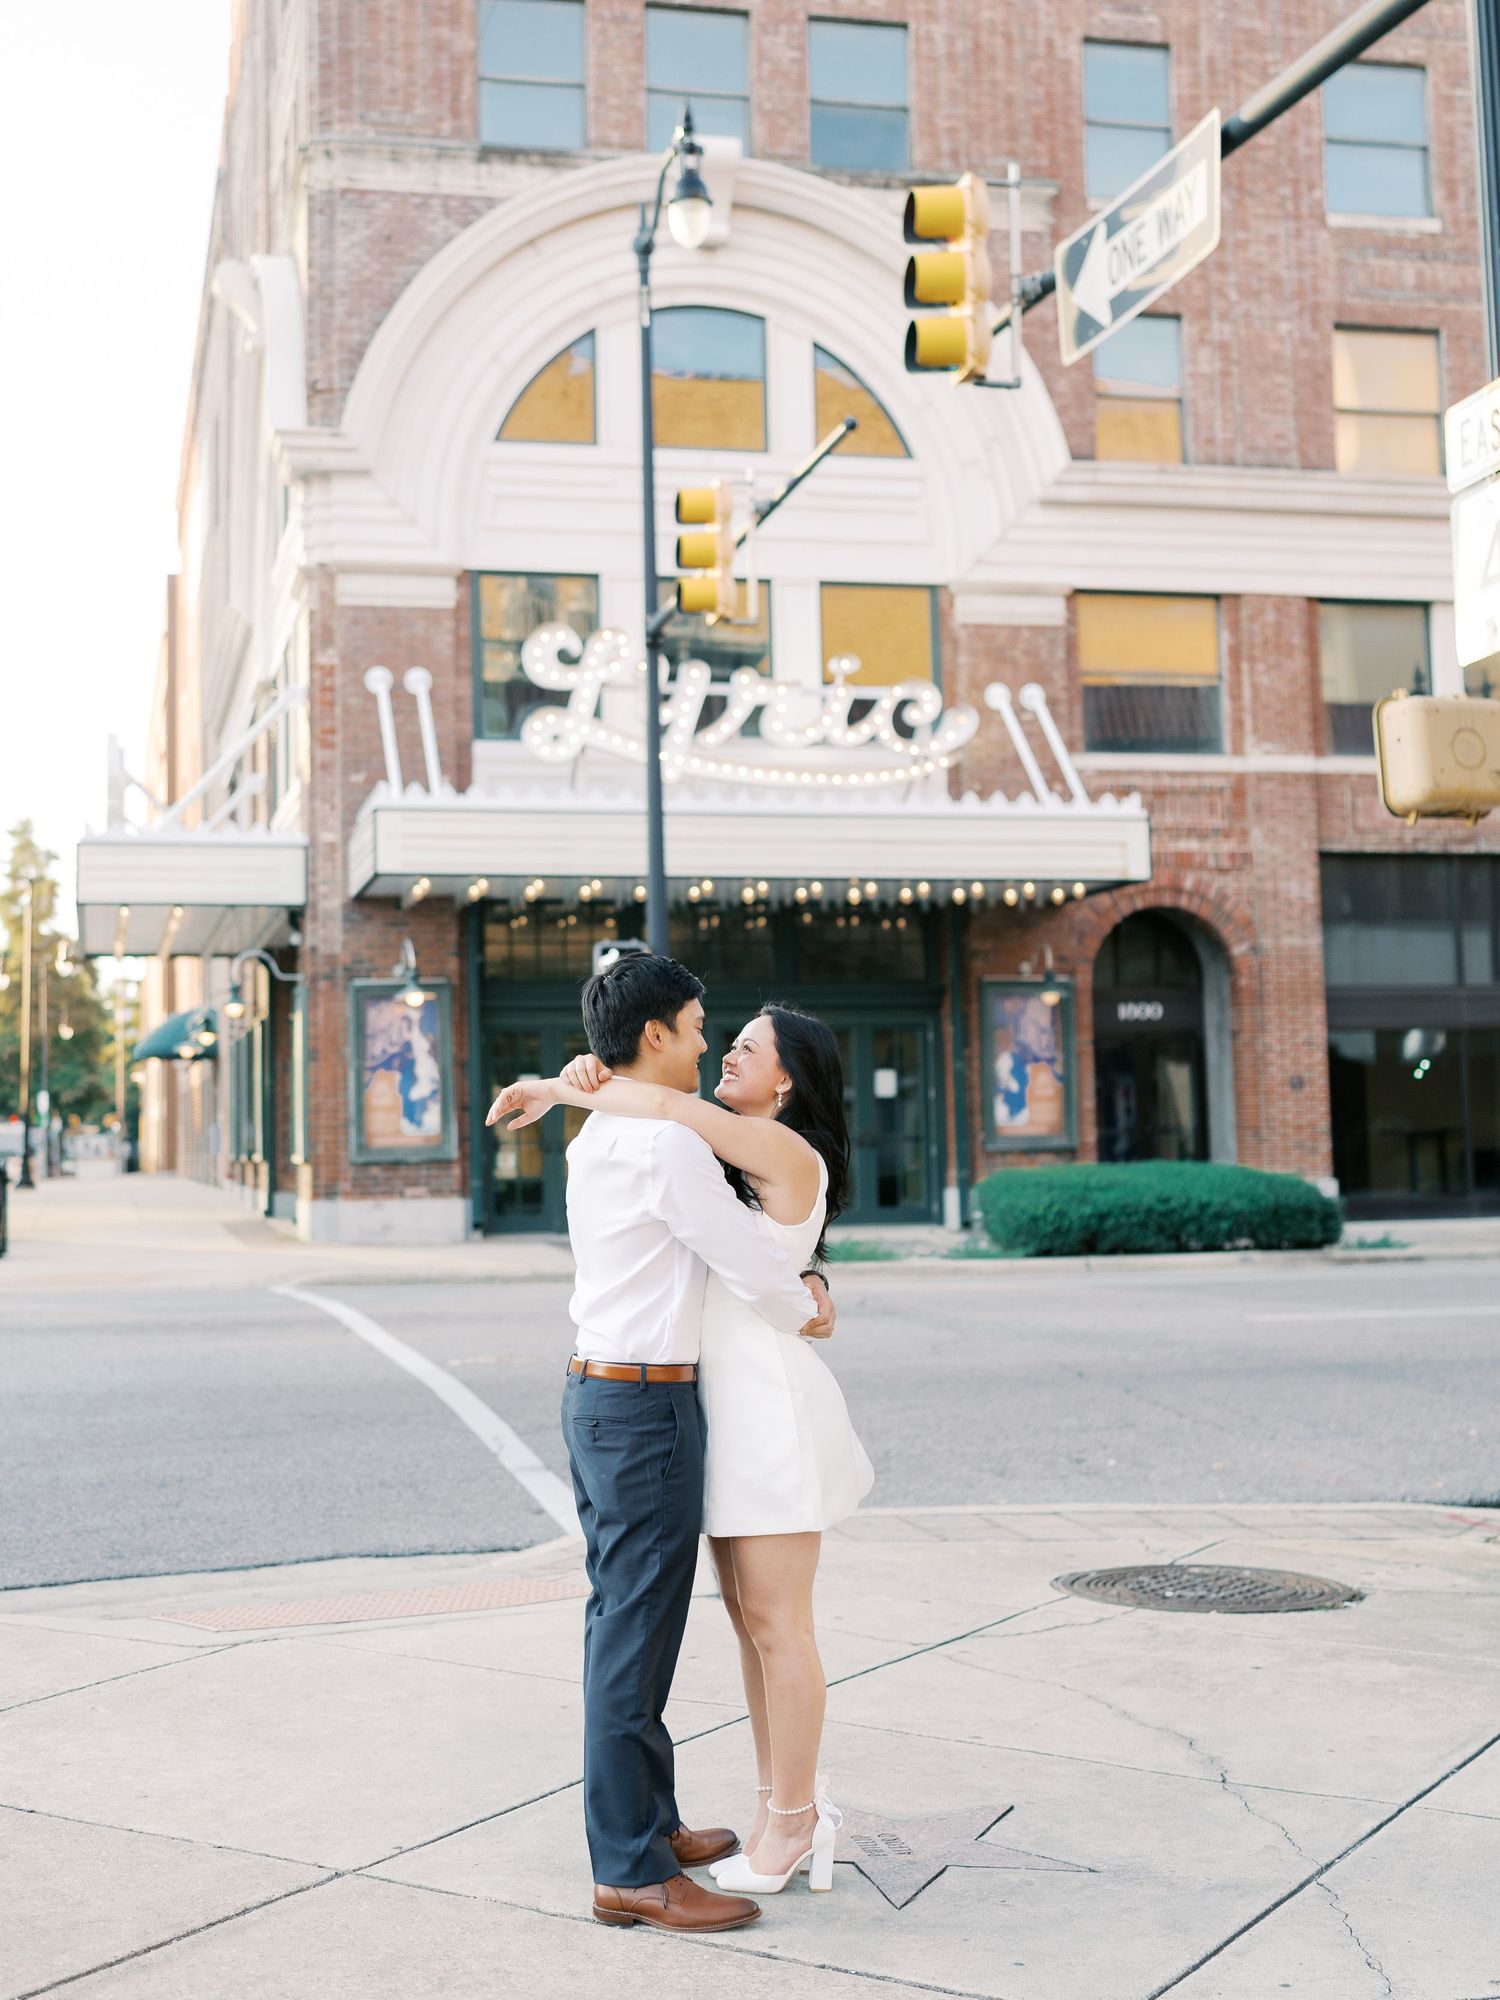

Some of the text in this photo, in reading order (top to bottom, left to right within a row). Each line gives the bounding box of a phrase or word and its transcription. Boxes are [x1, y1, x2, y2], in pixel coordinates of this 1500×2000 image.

[1107, 176, 1197, 286] ONE WAY
[520, 621, 981, 786] Lyric
